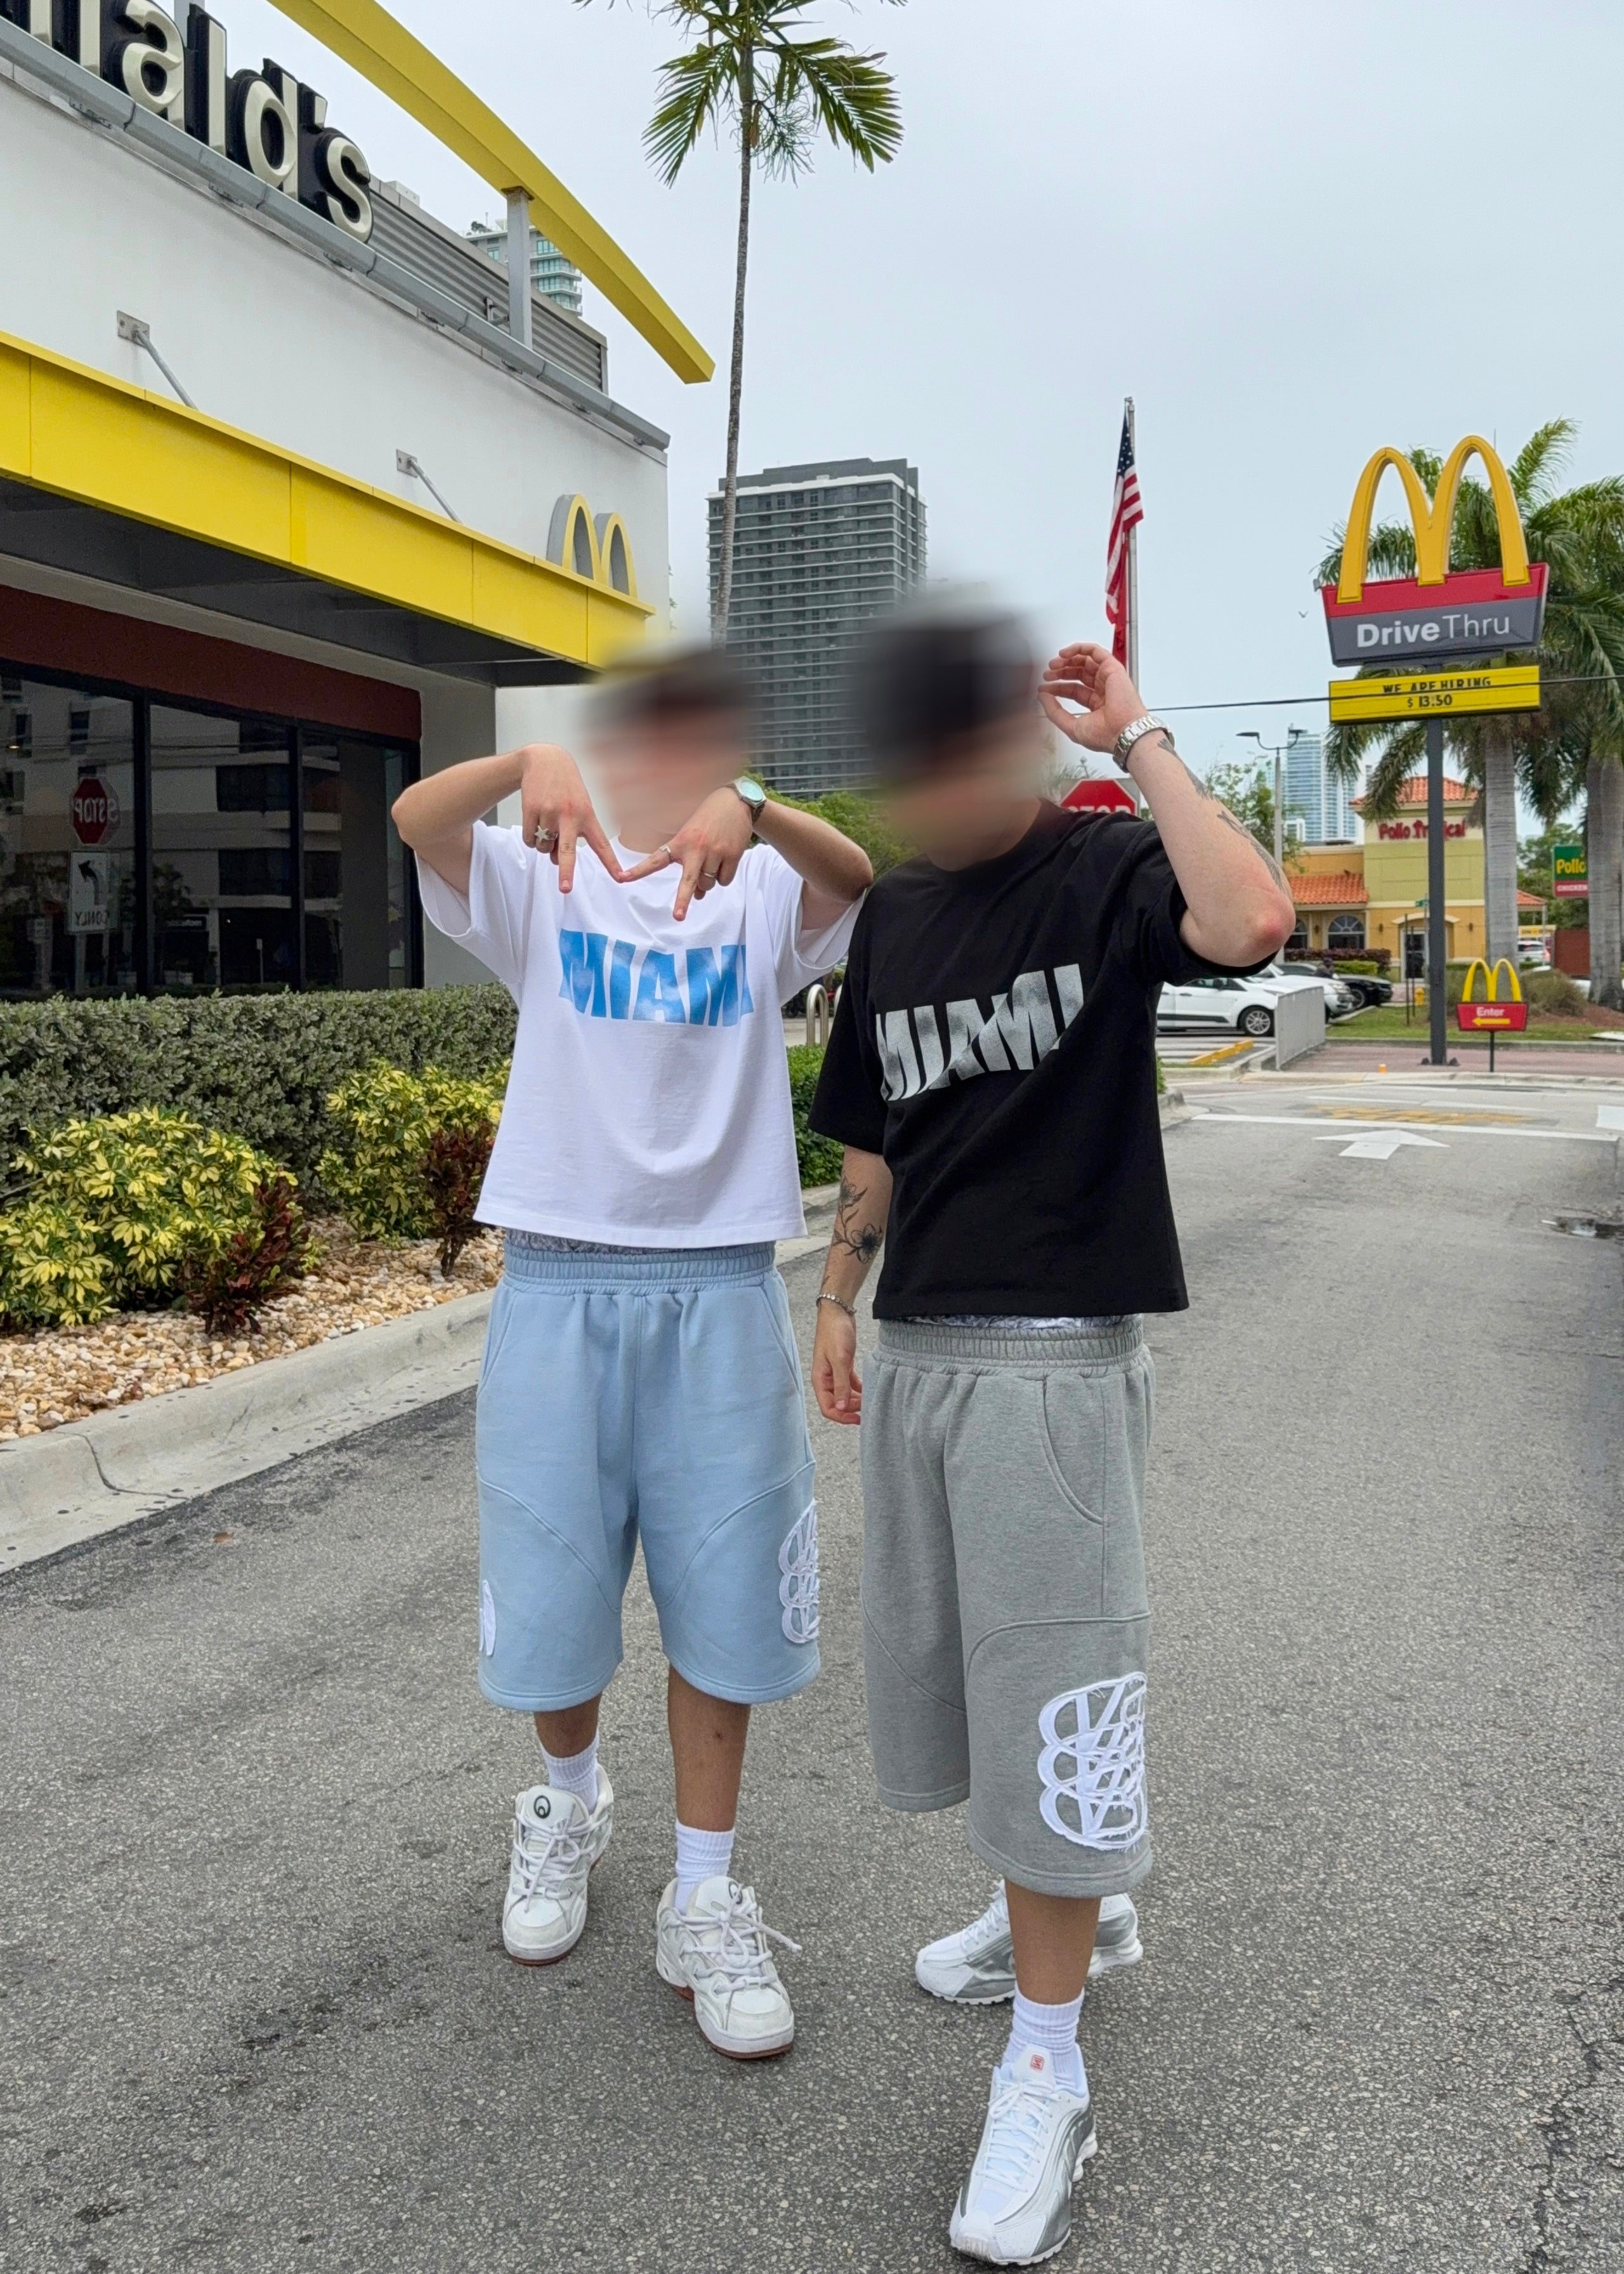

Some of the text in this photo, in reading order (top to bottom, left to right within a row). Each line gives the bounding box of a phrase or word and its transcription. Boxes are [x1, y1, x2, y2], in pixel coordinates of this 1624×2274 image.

[1357, 614, 1510, 648] Drive Thru
[1441, 676, 1491, 689] HIRING
[1418, 693, 1453, 707] 13.50
[1378, 820, 1466, 840] Pollo Trical
[558, 928, 755, 1027] MIAMI
[1476, 1006, 1505, 1016] Enter
[876, 963, 1084, 1101] MIAMI
